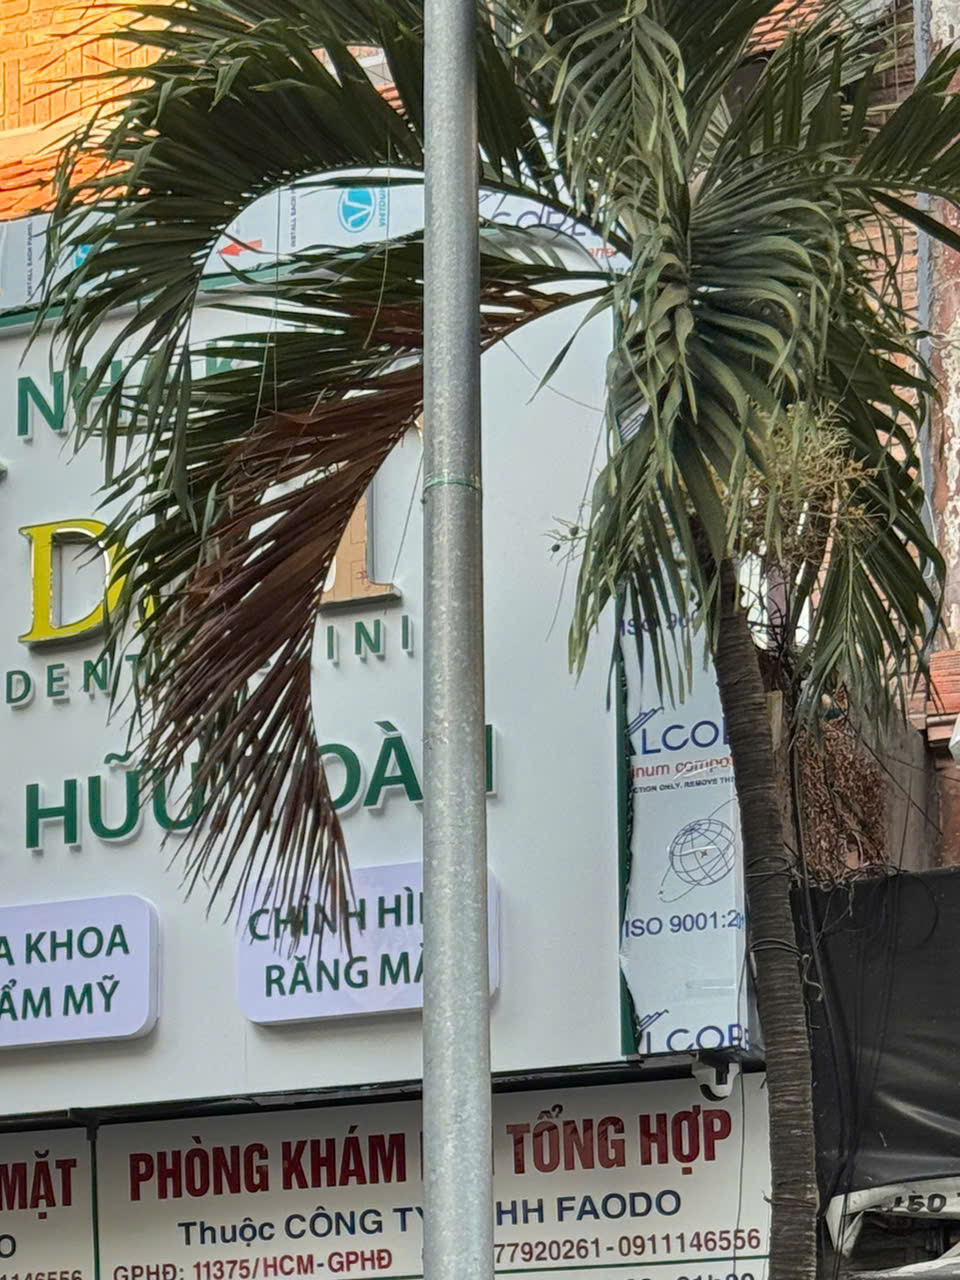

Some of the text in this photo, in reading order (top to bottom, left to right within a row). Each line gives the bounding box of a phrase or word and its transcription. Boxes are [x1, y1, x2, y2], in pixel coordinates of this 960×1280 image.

[675, 755, 733, 774] compo
[378, 886, 424, 929] HÌ
[624, 915, 663, 938] ISO
[25, 923, 130, 965] KHOA
[63, 974, 121, 1017] MỸ
[265, 954, 368, 998] RĂNG
[506, 1103, 626, 1175] TỔNG
[640, 1105, 732, 1176] HỢP
[129, 1135, 270, 1201] PHÒNG
[282, 1124, 407, 1190] KHÁM
[178, 1216, 275, 1248] Thuộc
[284, 1205, 383, 1239] CÔNG
[495, 1189, 682, 1226] HH FAODO
[494, 1228, 761, 1265] 77920261-0911146556
